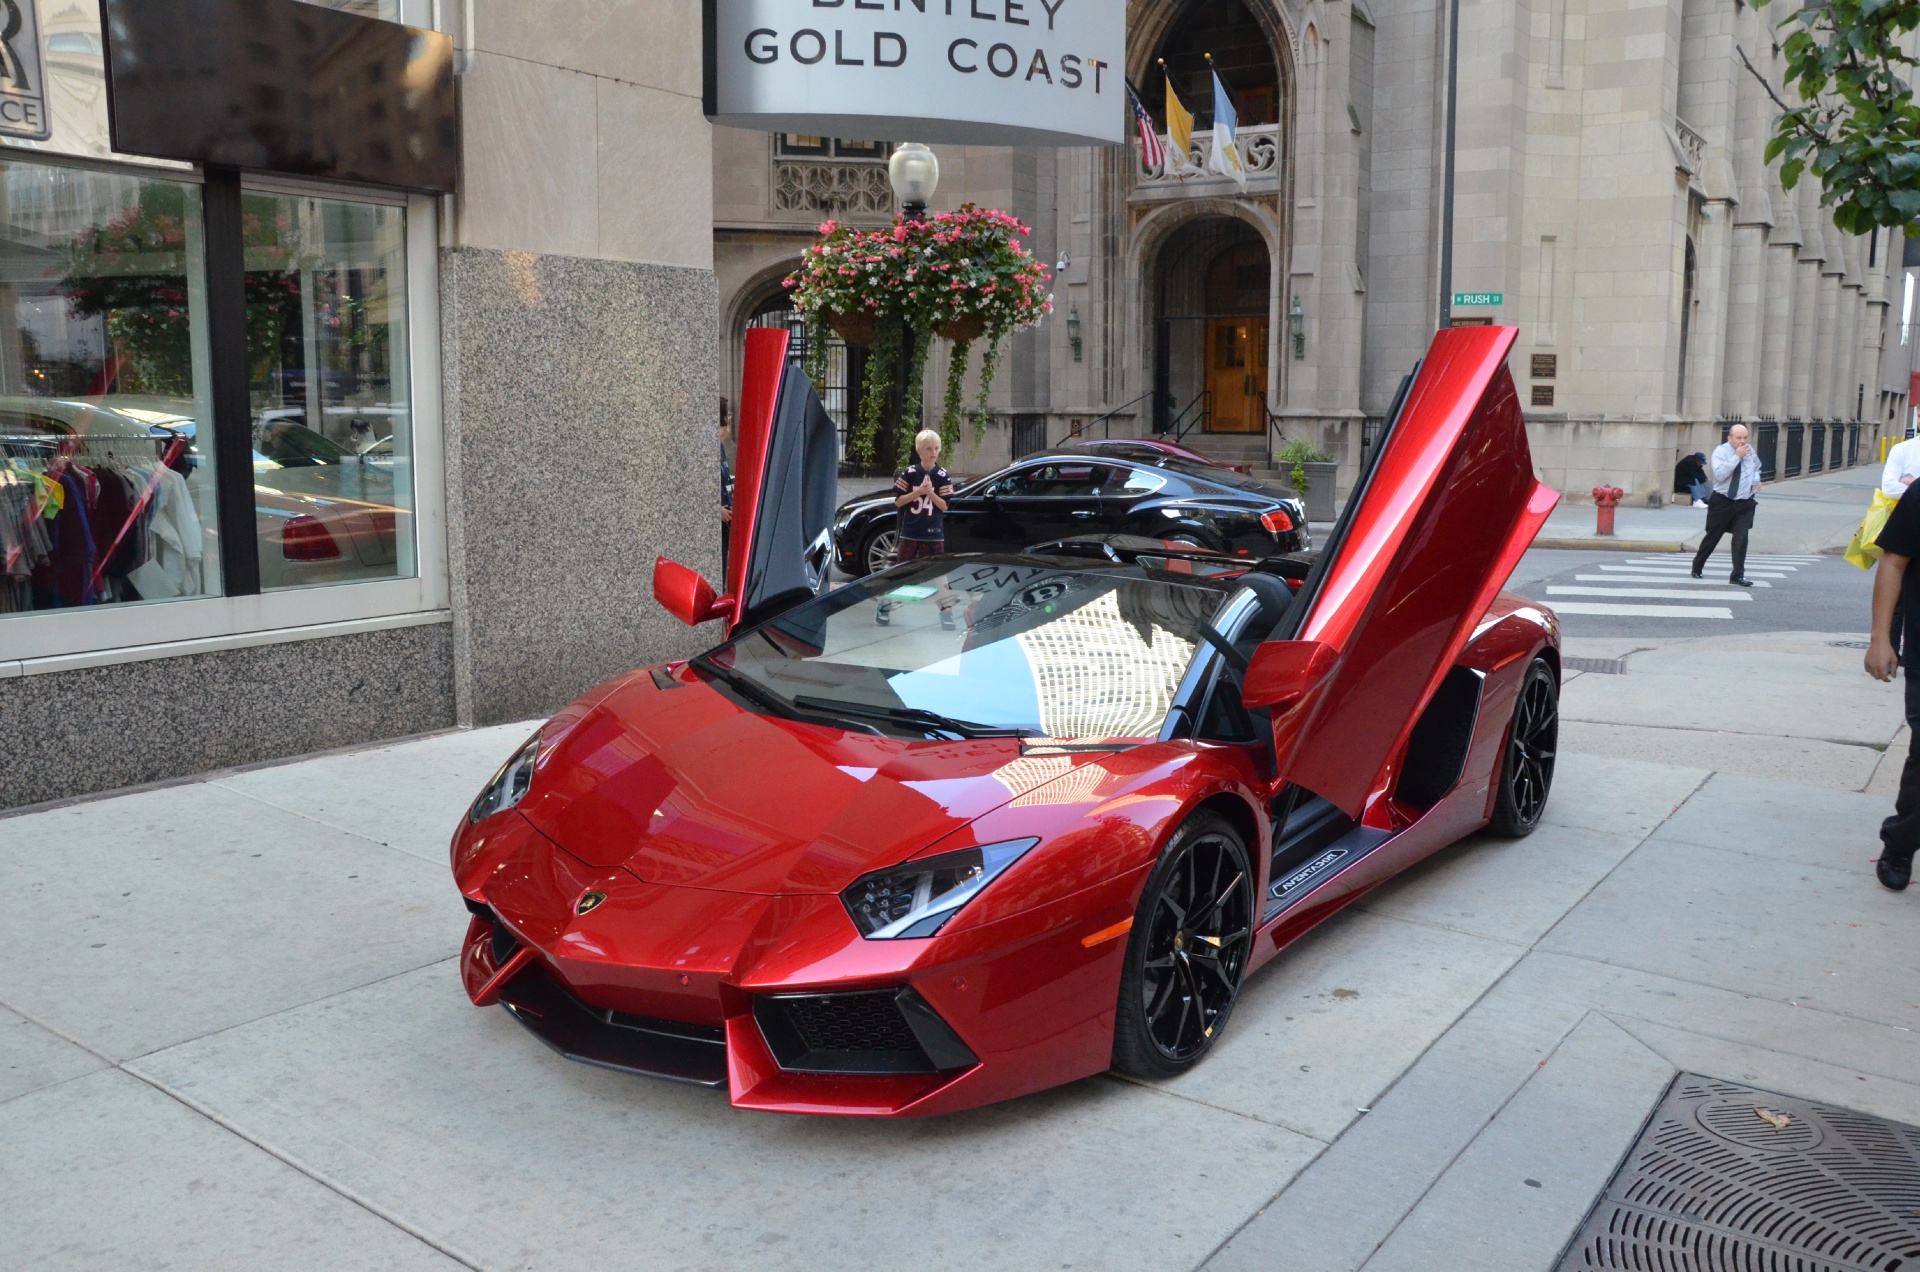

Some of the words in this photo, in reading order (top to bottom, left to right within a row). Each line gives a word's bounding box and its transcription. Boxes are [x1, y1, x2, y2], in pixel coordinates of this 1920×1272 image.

[744, 27, 908, 68] GOLD
[947, 37, 1108, 94] COAST
[1464, 294, 1490, 304] RUSH
[910, 485, 934, 517] 54
[1282, 853, 1338, 890] AVENTADOR
